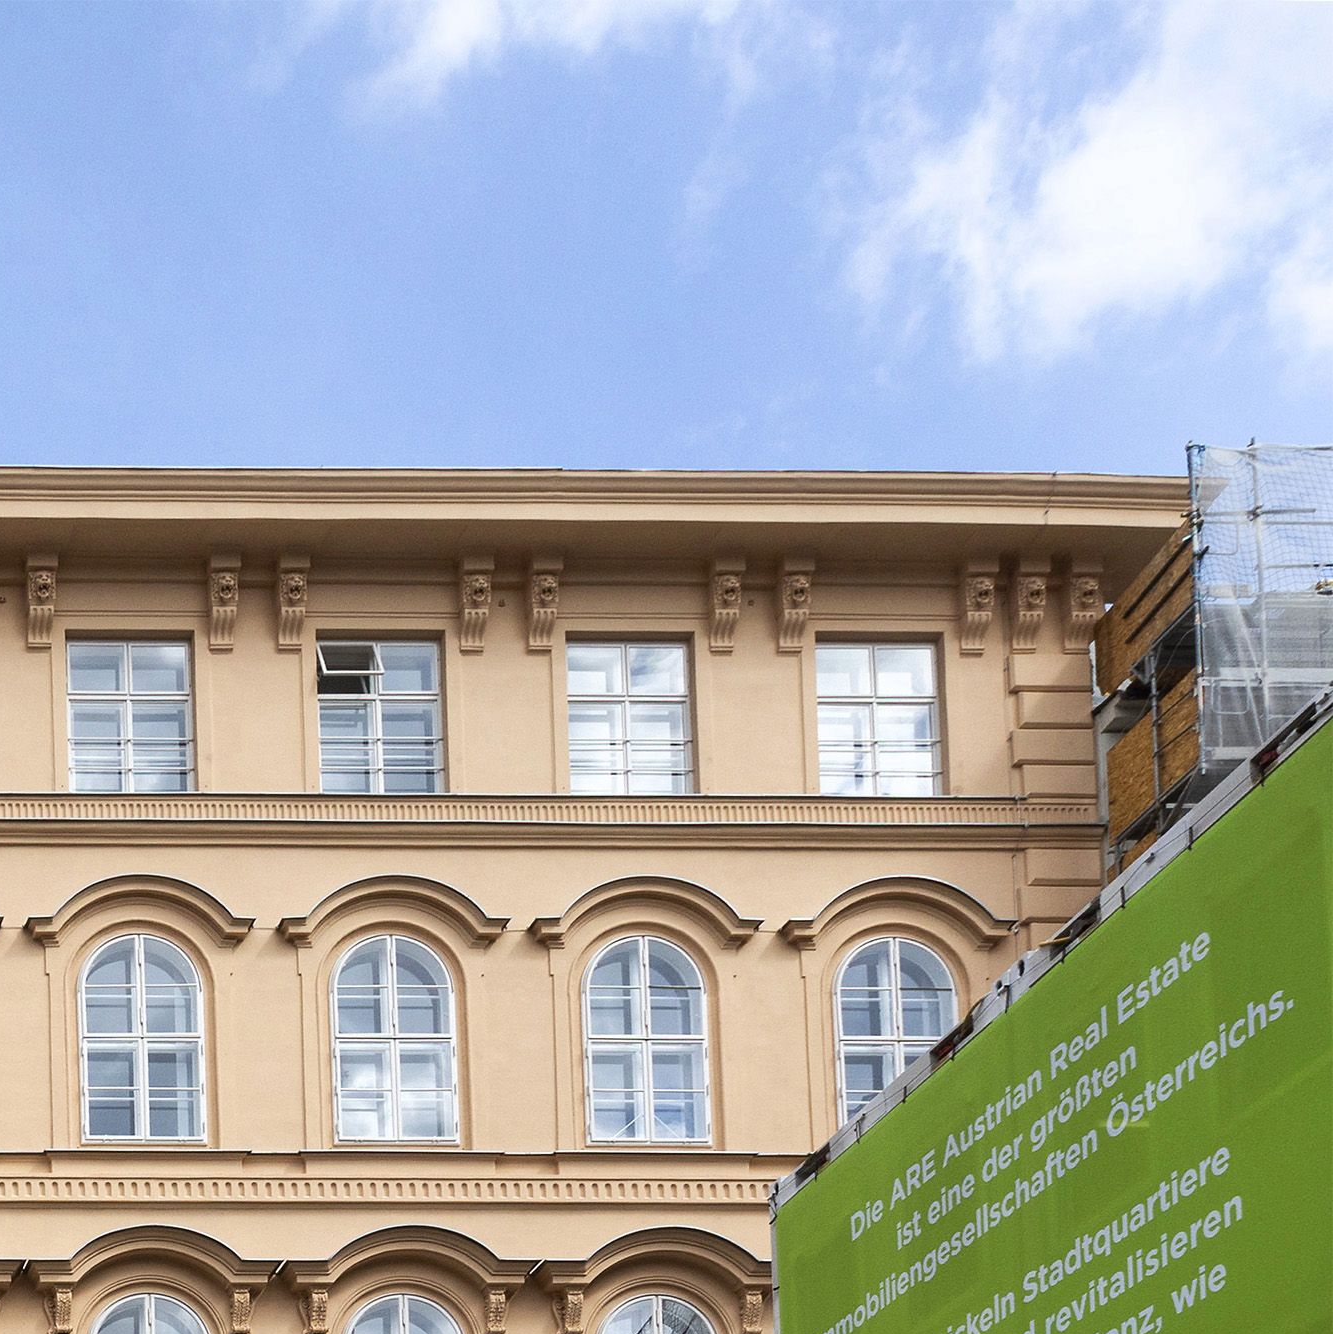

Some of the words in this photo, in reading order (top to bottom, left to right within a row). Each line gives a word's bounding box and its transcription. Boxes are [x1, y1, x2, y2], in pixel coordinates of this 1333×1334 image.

[849, 1199, 884, 1241] Die
[891, 1151, 936, 1207] ARE
[943, 1071, 1041, 1166] Austrian
[1050, 1008, 1107, 1079] Real
[1117, 932, 1209, 1023] Estate
[1107, 992, 1293, 1136] Österreichs.
[896, 1208, 922, 1250] ist
[928, 1174, 975, 1224] eine
[982, 1136, 1022, 1181] der
[1030, 1046, 1136, 1151] größten
[1022, 1147, 1231, 1306] Stadtquartiere
[1172, 1265, 1226, 1312] wie
